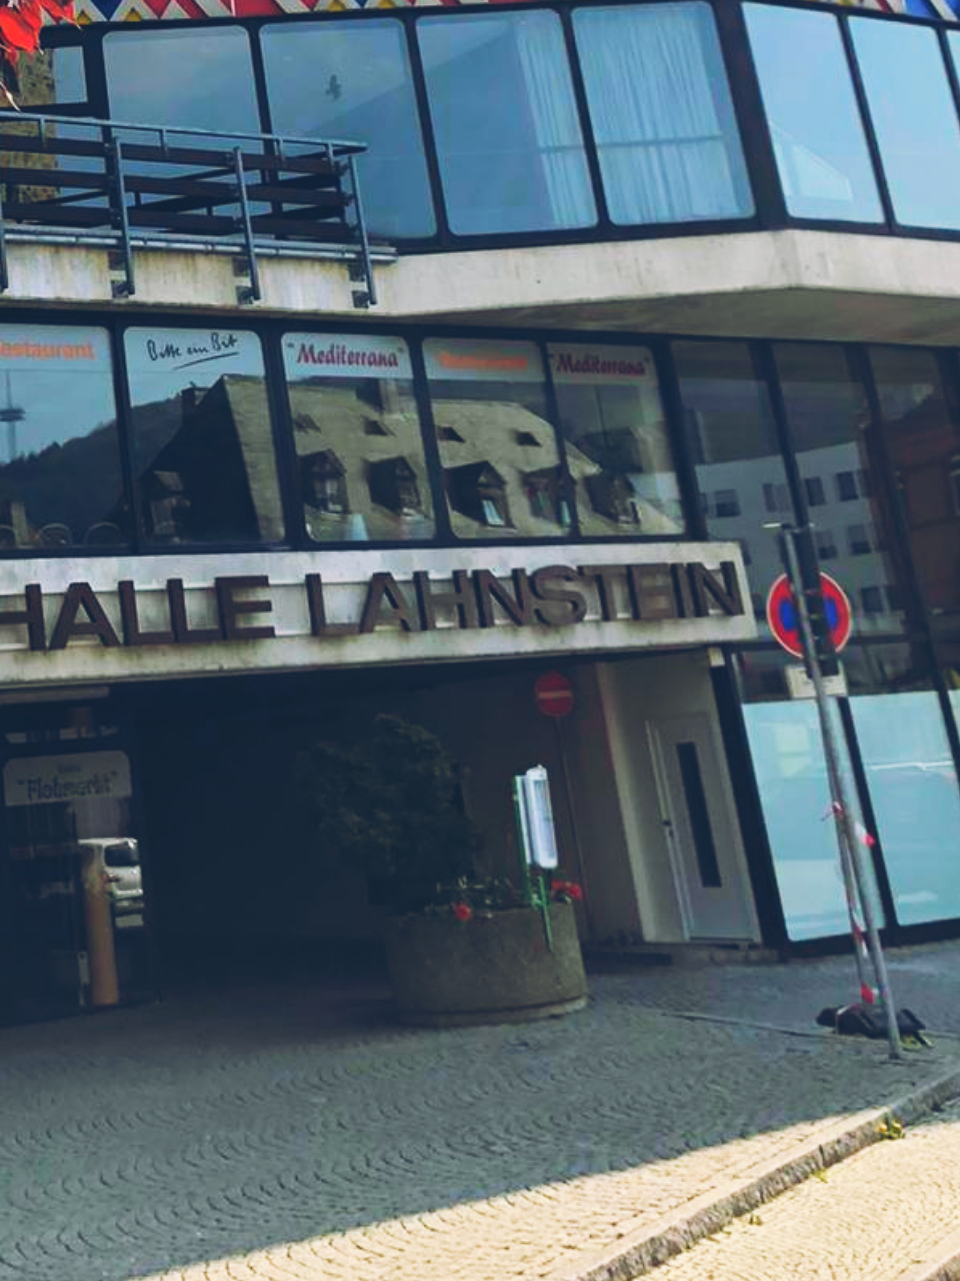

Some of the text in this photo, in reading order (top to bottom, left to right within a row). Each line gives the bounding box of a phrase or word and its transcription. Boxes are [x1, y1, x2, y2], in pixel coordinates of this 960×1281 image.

[187, 344, 209, 356] ein
[211, 332, 238, 351] Bit
[304, 560, 746, 637] LAHNSTEIN
